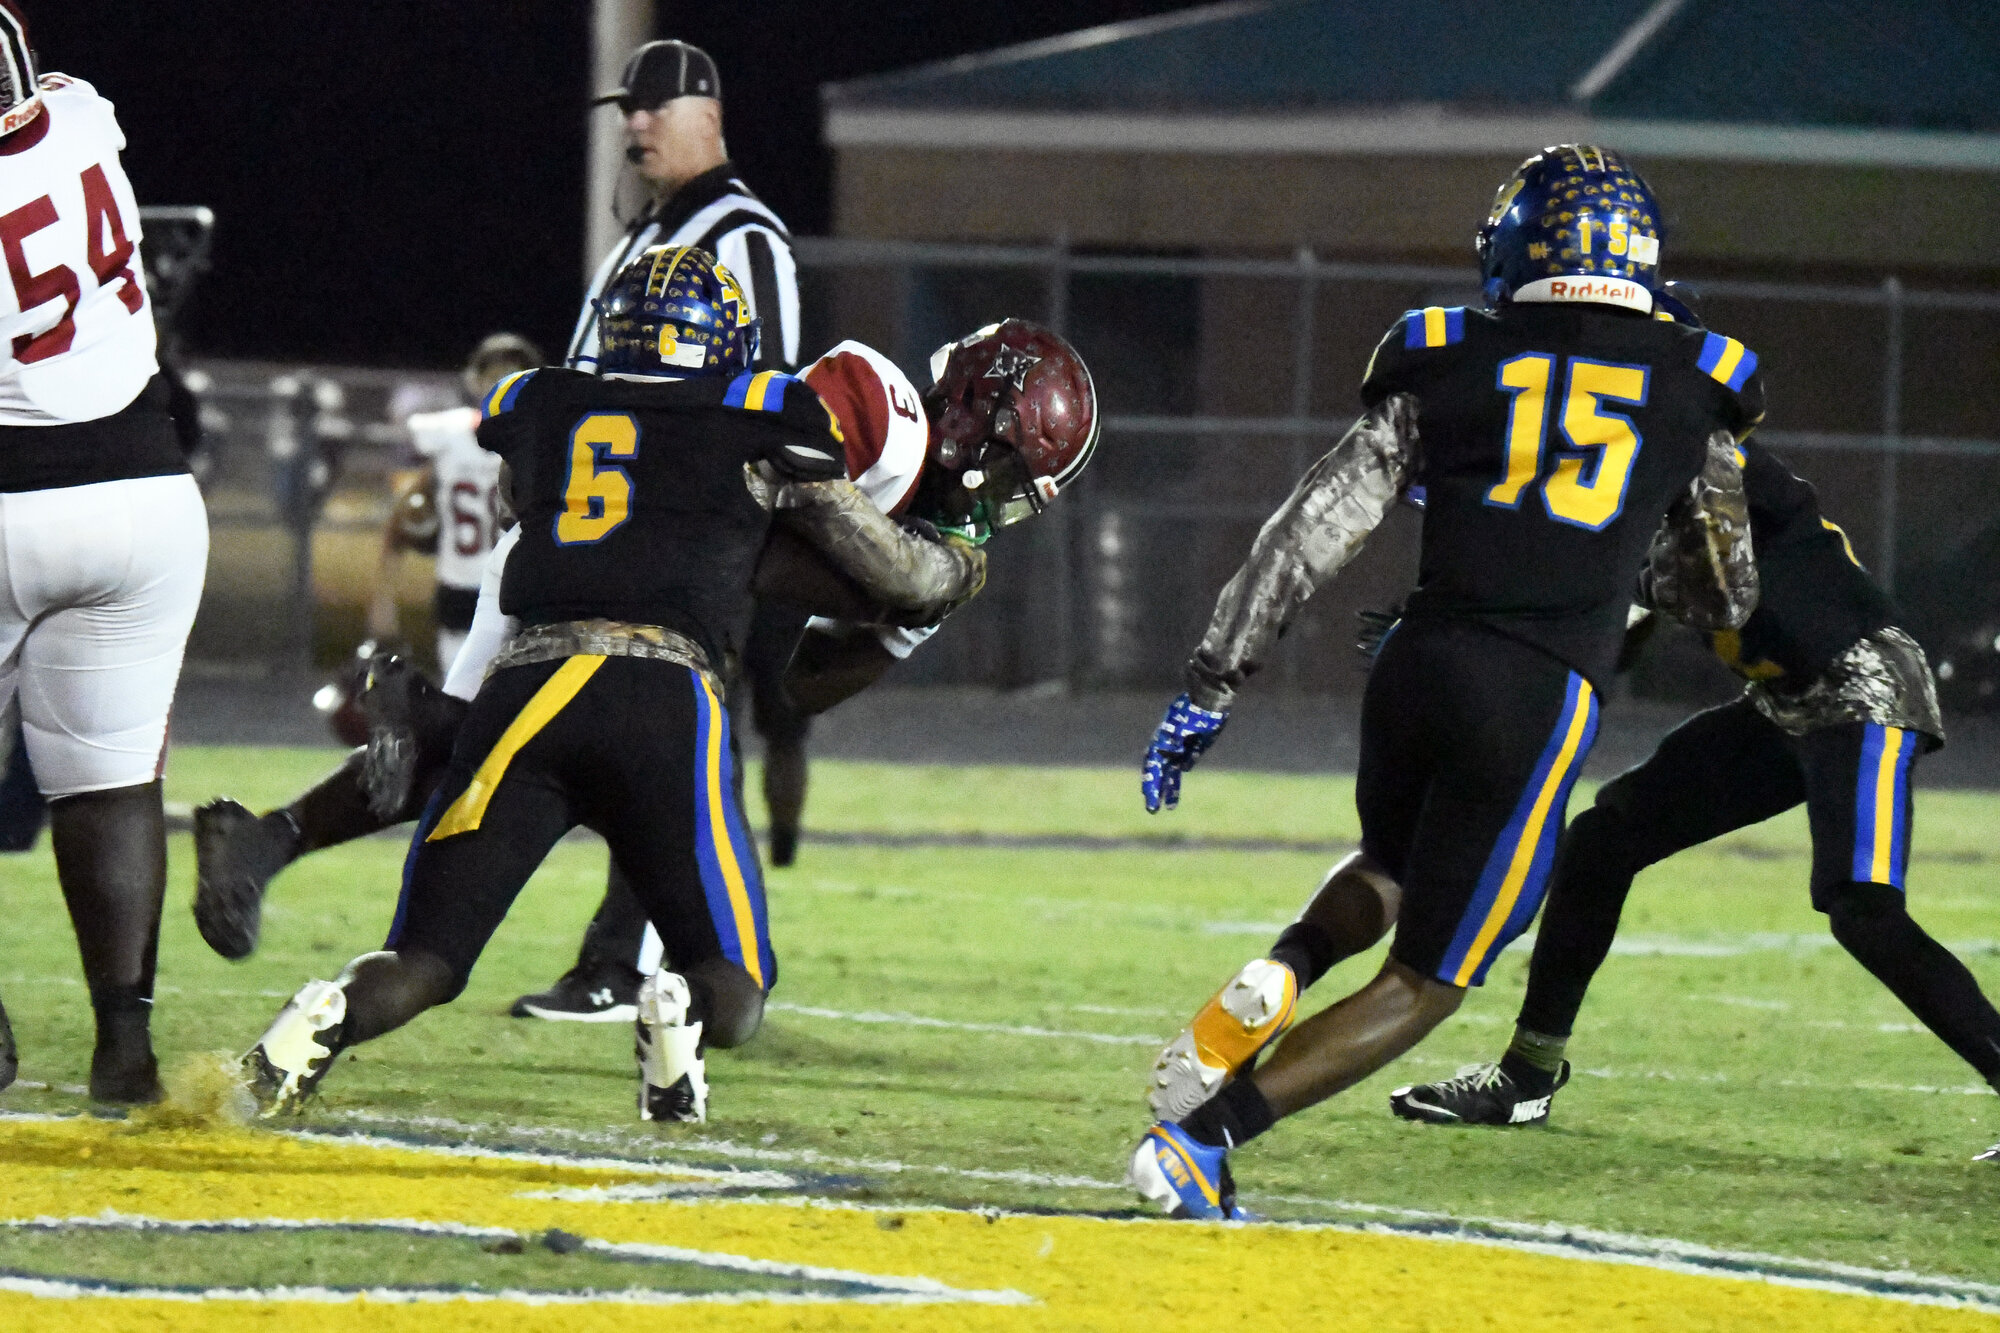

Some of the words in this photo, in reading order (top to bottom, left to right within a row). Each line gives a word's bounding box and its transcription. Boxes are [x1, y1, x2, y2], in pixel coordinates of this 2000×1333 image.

[1577, 216, 1628, 256] 15
[0, 163, 143, 365] 54
[1551, 281, 1635, 299] Riddell
[659, 323, 679, 356] 6
[889, 384, 918, 424] 3
[1483, 351, 1651, 532] 15
[552, 411, 642, 547] 6
